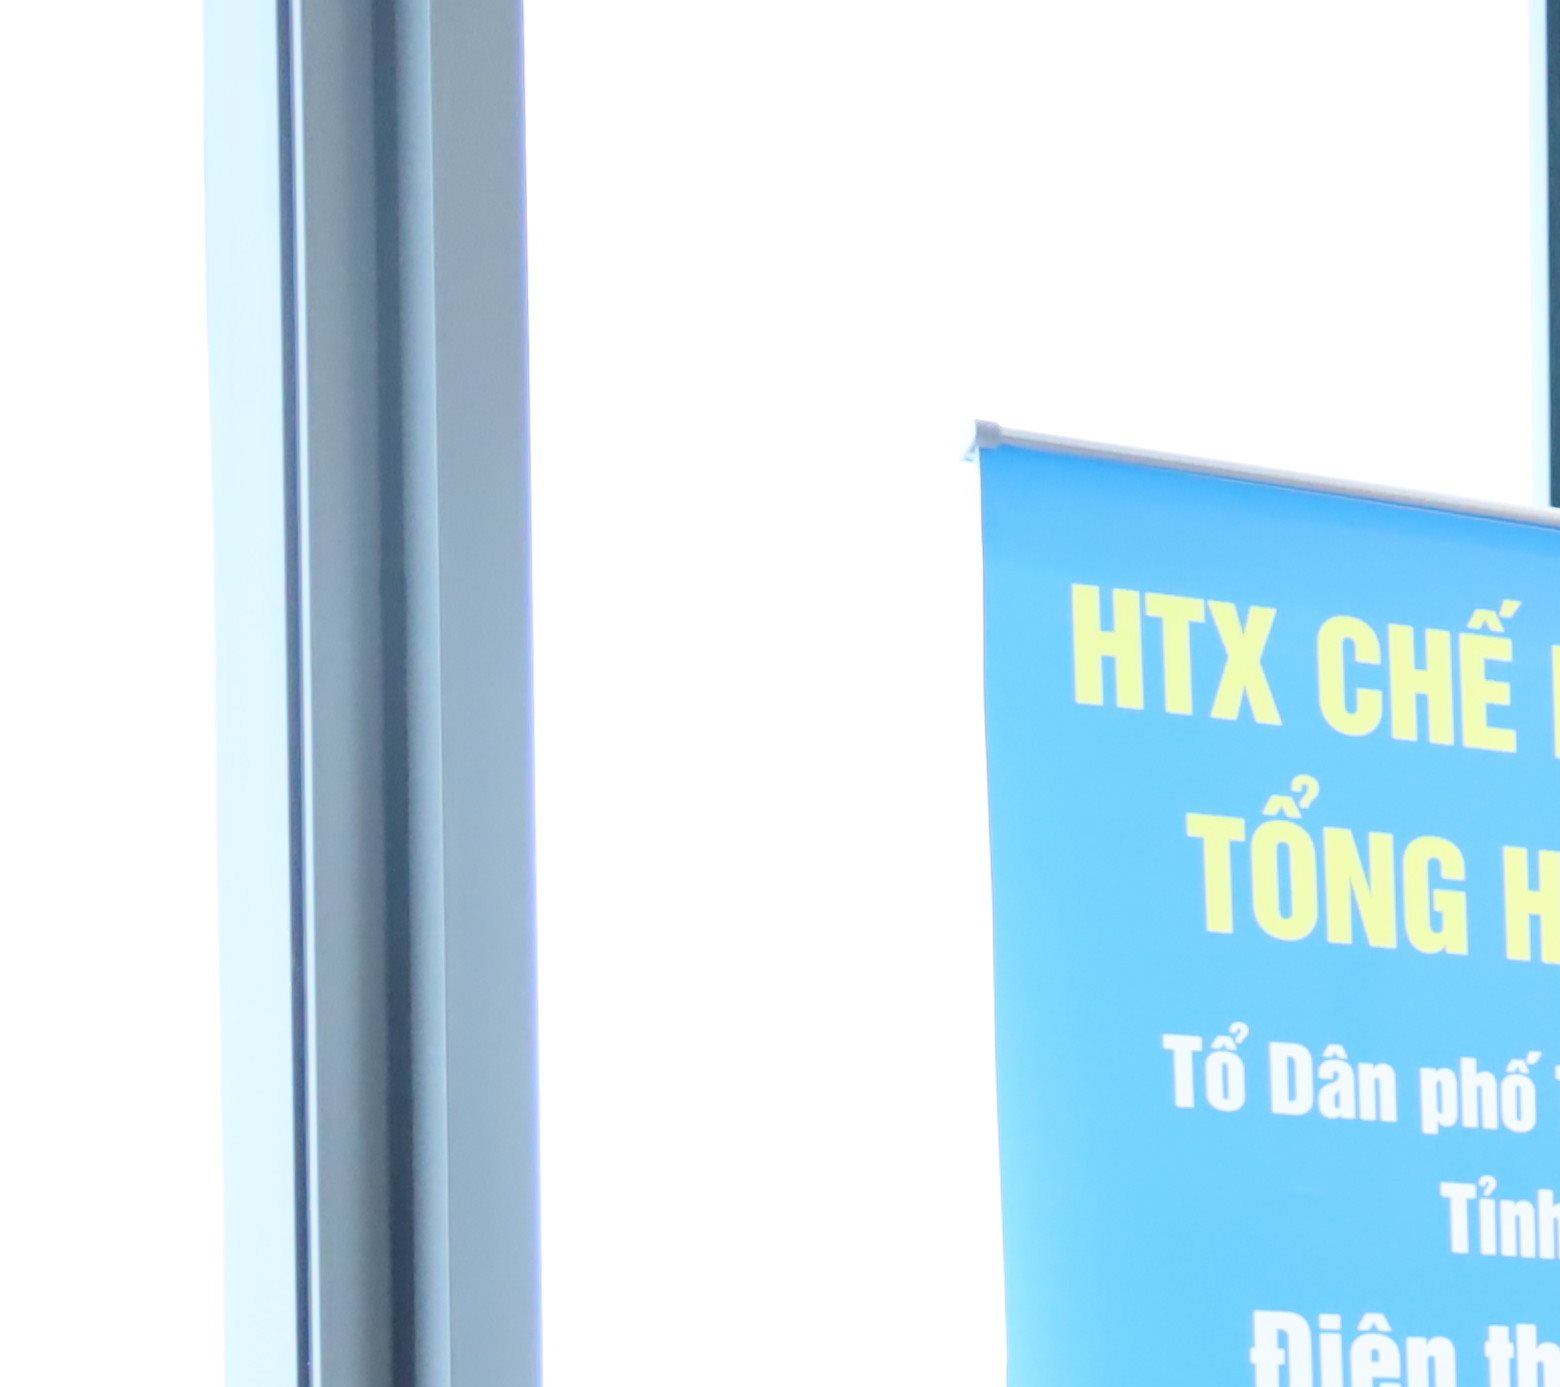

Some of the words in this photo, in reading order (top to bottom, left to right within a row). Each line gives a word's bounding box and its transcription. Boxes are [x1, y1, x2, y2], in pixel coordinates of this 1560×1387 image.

[1071, 582, 1282, 727] HTX
[1317, 597, 1522, 755] CHẾ
[1186, 773, 1467, 955] TỔNG
[1163, 1022, 1249, 1112] Tổ
[1268, 1042, 1398, 1125] Dân
[1420, 1049, 1541, 1135] phố
